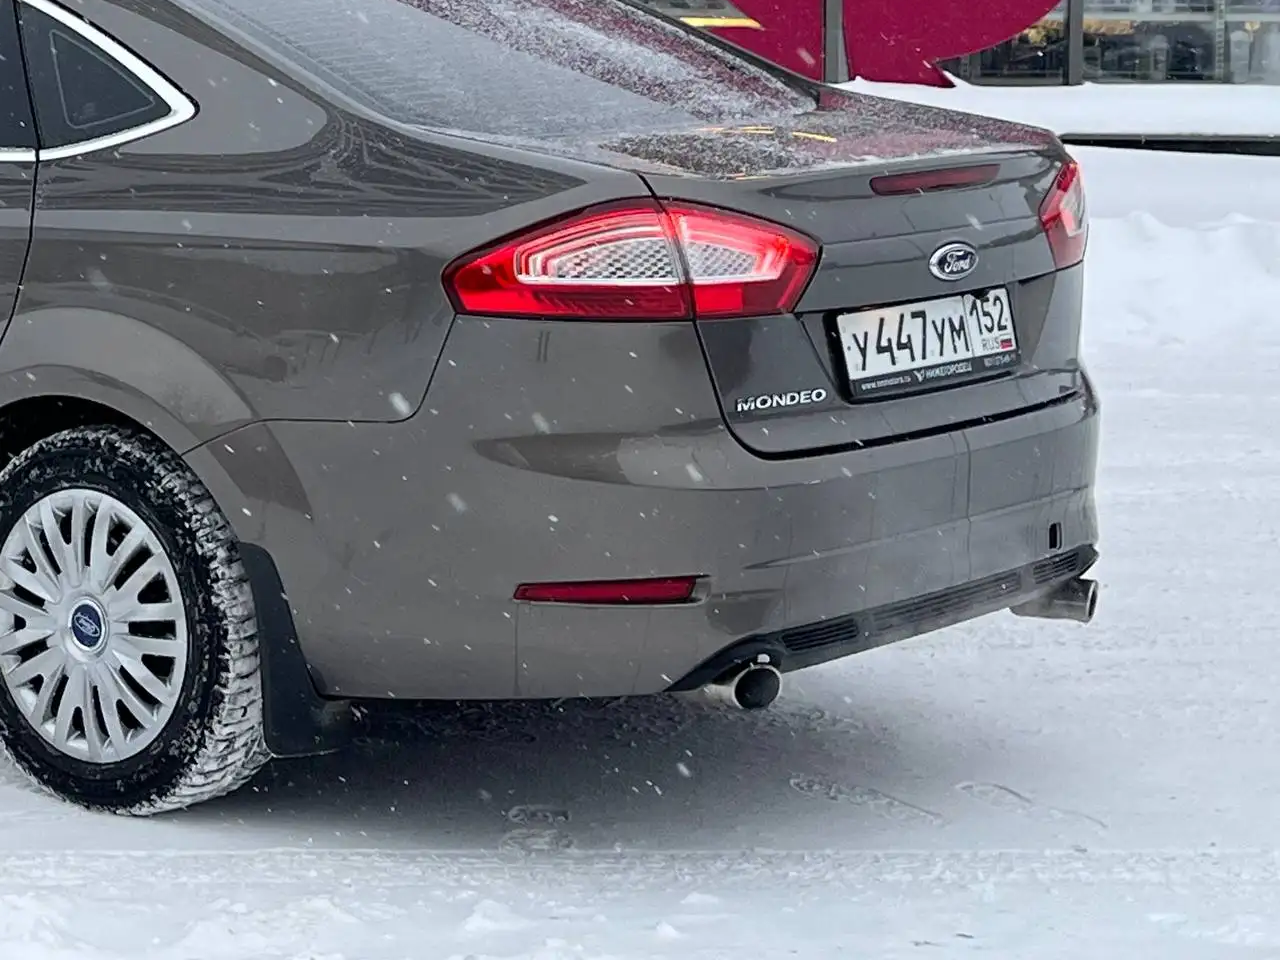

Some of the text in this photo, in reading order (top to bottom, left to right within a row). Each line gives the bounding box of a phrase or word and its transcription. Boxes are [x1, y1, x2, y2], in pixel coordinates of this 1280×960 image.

[944, 251, 972, 273] Ford
[852, 309, 970, 372] У447УМ
[970, 295, 1008, 336] 152
[736, 388, 827, 412] MONDEO
